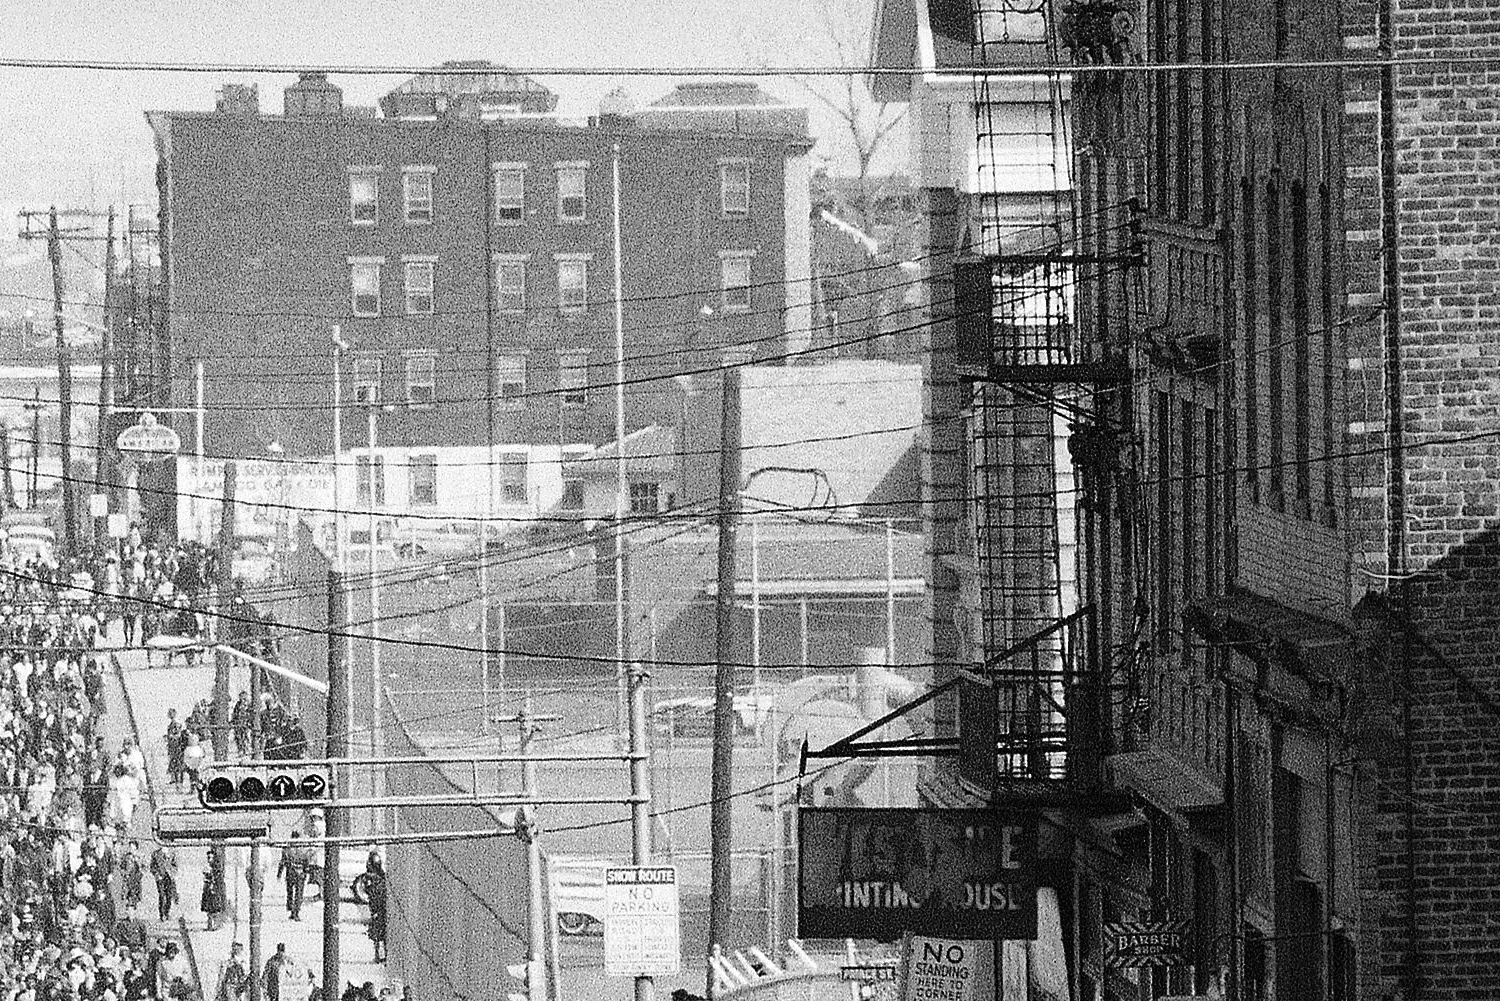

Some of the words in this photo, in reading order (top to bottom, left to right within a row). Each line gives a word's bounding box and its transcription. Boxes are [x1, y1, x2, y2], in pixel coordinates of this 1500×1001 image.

[638, 870, 674, 882] ROUTE
[629, 886, 653, 900] NO
[611, 901, 669, 913] PARKING
[1118, 933, 1182, 952] BARBER
[922, 942, 964, 964] NO
[915, 962, 969, 980] STANDING
[917, 978, 944, 990] HERE
[950, 980, 963, 991] TO
[916, 987, 963, 1001] CORNER
